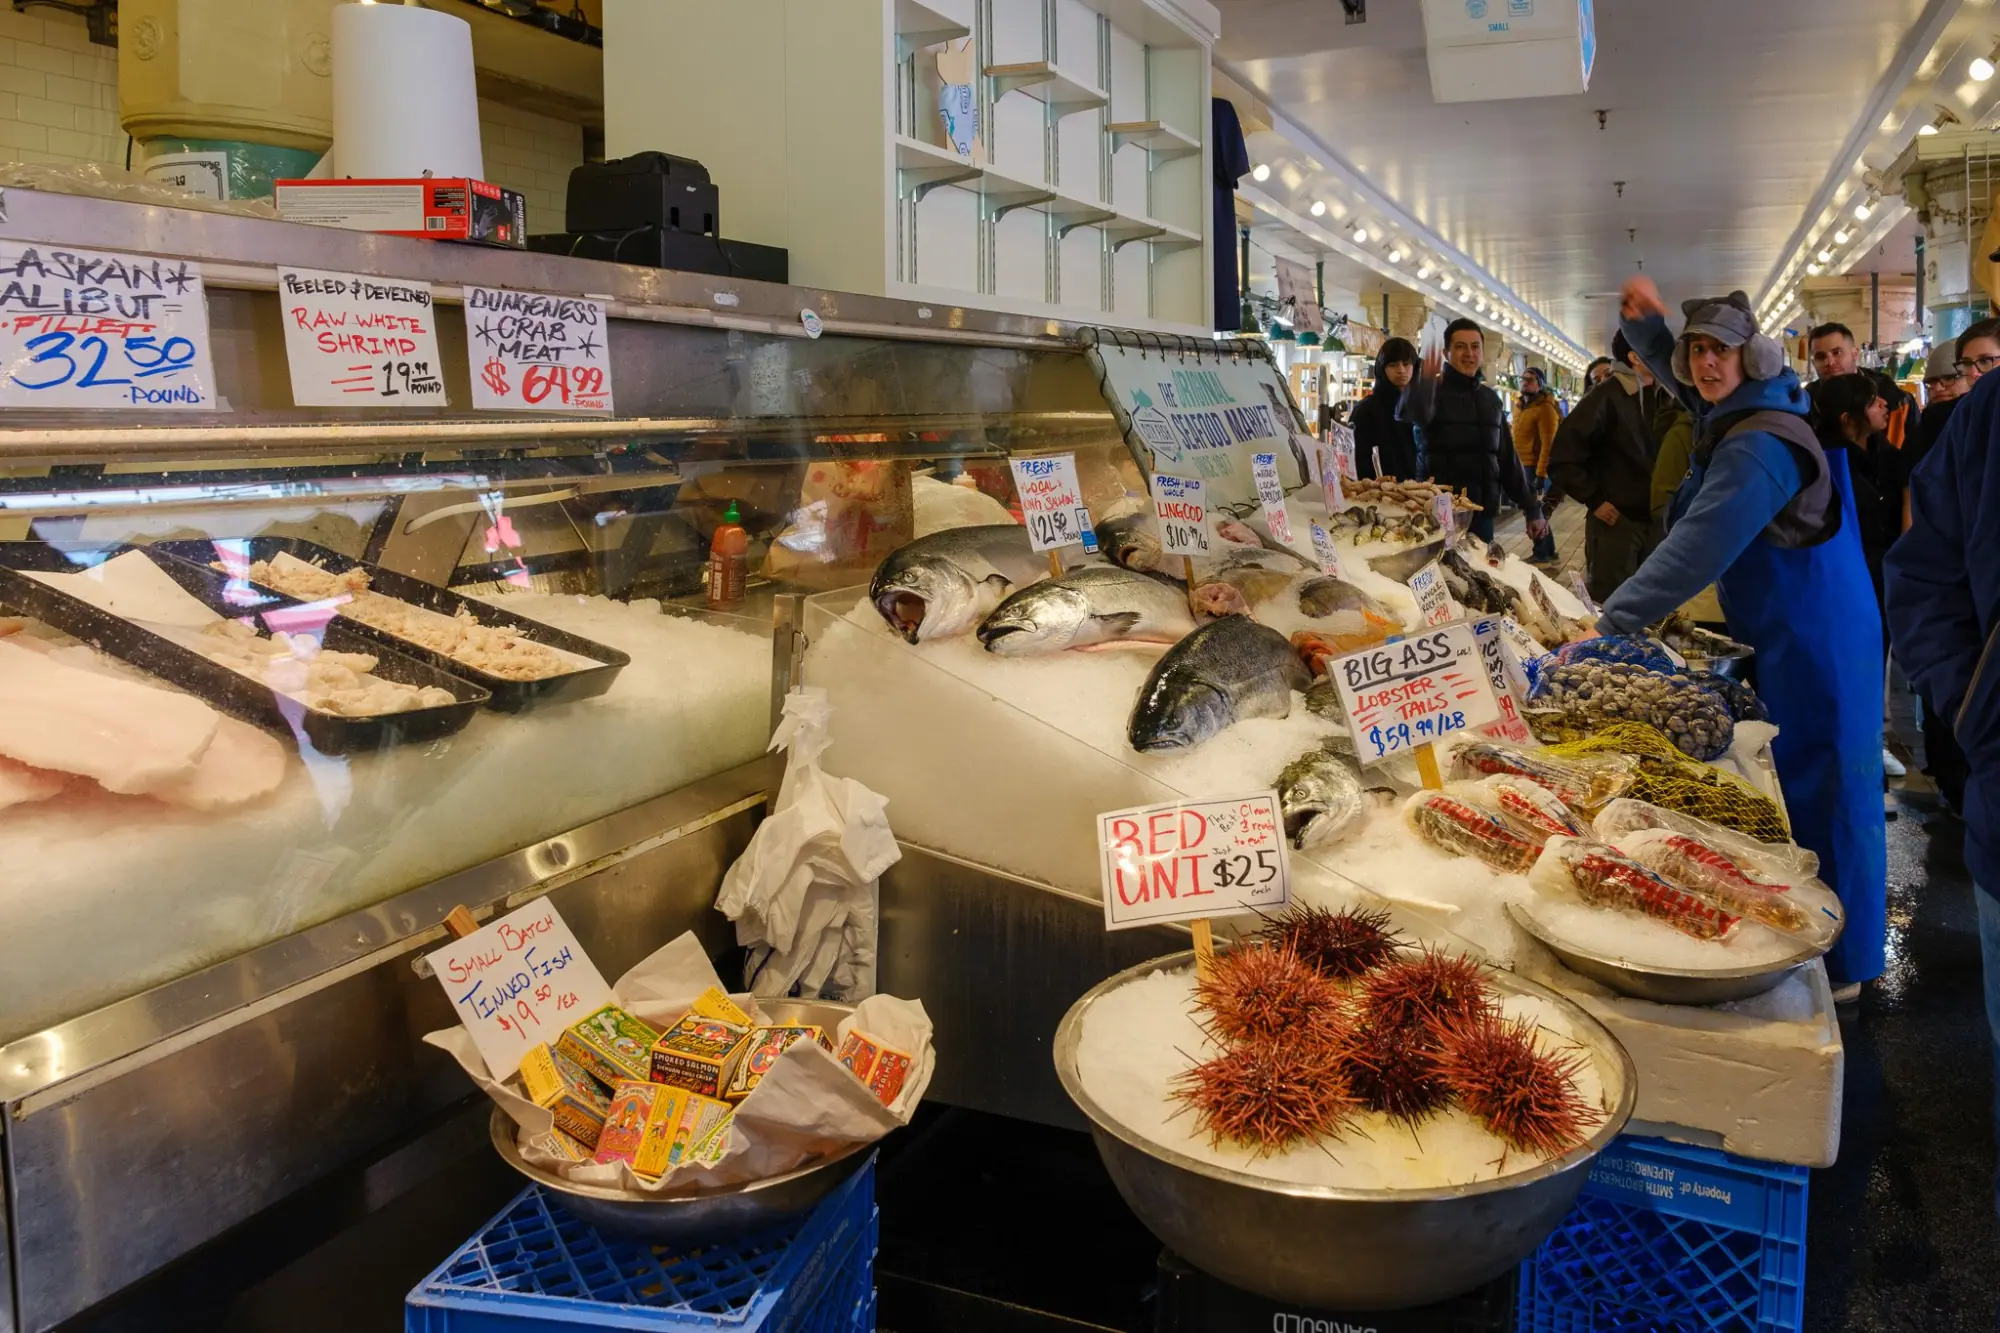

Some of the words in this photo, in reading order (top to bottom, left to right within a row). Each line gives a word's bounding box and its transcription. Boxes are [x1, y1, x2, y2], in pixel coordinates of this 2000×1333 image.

[1488, 22, 1509, 33] SMALL
[0, 248, 163, 290] ASKAN
[0, 281, 166, 319] ALIBUT
[284, 273, 346, 295] PEELED
[364, 283, 430, 308] DEVEINED
[470, 288, 597, 325] DUNGENESS
[291, 307, 346, 332] RAW
[355, 312, 426, 333] WHITE
[498, 315, 566, 342] CRAB
[317, 332, 416, 356] SHRIMP
[498, 340, 575, 361] MEAT
[411, 383, 441, 394] POUND
[1157, 383, 1178, 408] THE
[1171, 409, 1232, 450] SEAFOOD
[1224, 405, 1277, 443] MARKET
[1020, 460, 1054, 475] FRESH
[1025, 480, 1057, 494] LOCAL
[1157, 476, 1180, 488] FRESH
[1185, 480, 1200, 490] WILD
[1343, 651, 1393, 687] BIG
[1399, 633, 1452, 669] ASS
[1352, 677, 1436, 716] LOBSTER
[1395, 692, 1449, 720] TAILS
[1240, 803, 1271, 817] Clean
[1113, 810, 1207, 856] RED
[1116, 854, 1215, 906] UNI
[1213, 849, 1277, 888] $25
[447, 948, 503, 983] SMALL
[497, 914, 555, 951] BATCH
[459, 972, 531, 1020] TINNED
[523, 946, 573, 979] FISH
[653, 1052, 685, 1066] SMOKED
[686, 1060, 719, 1074] SALMON
[878, 1055, 896, 1089] SALMON
[1599, 1171, 1645, 1193] BROTHERS
[1624, 1159, 1675, 1182] ALPENROSE
[1646, 1180, 1674, 1199] SMITH
[1692, 1180, 1732, 1205] Property
